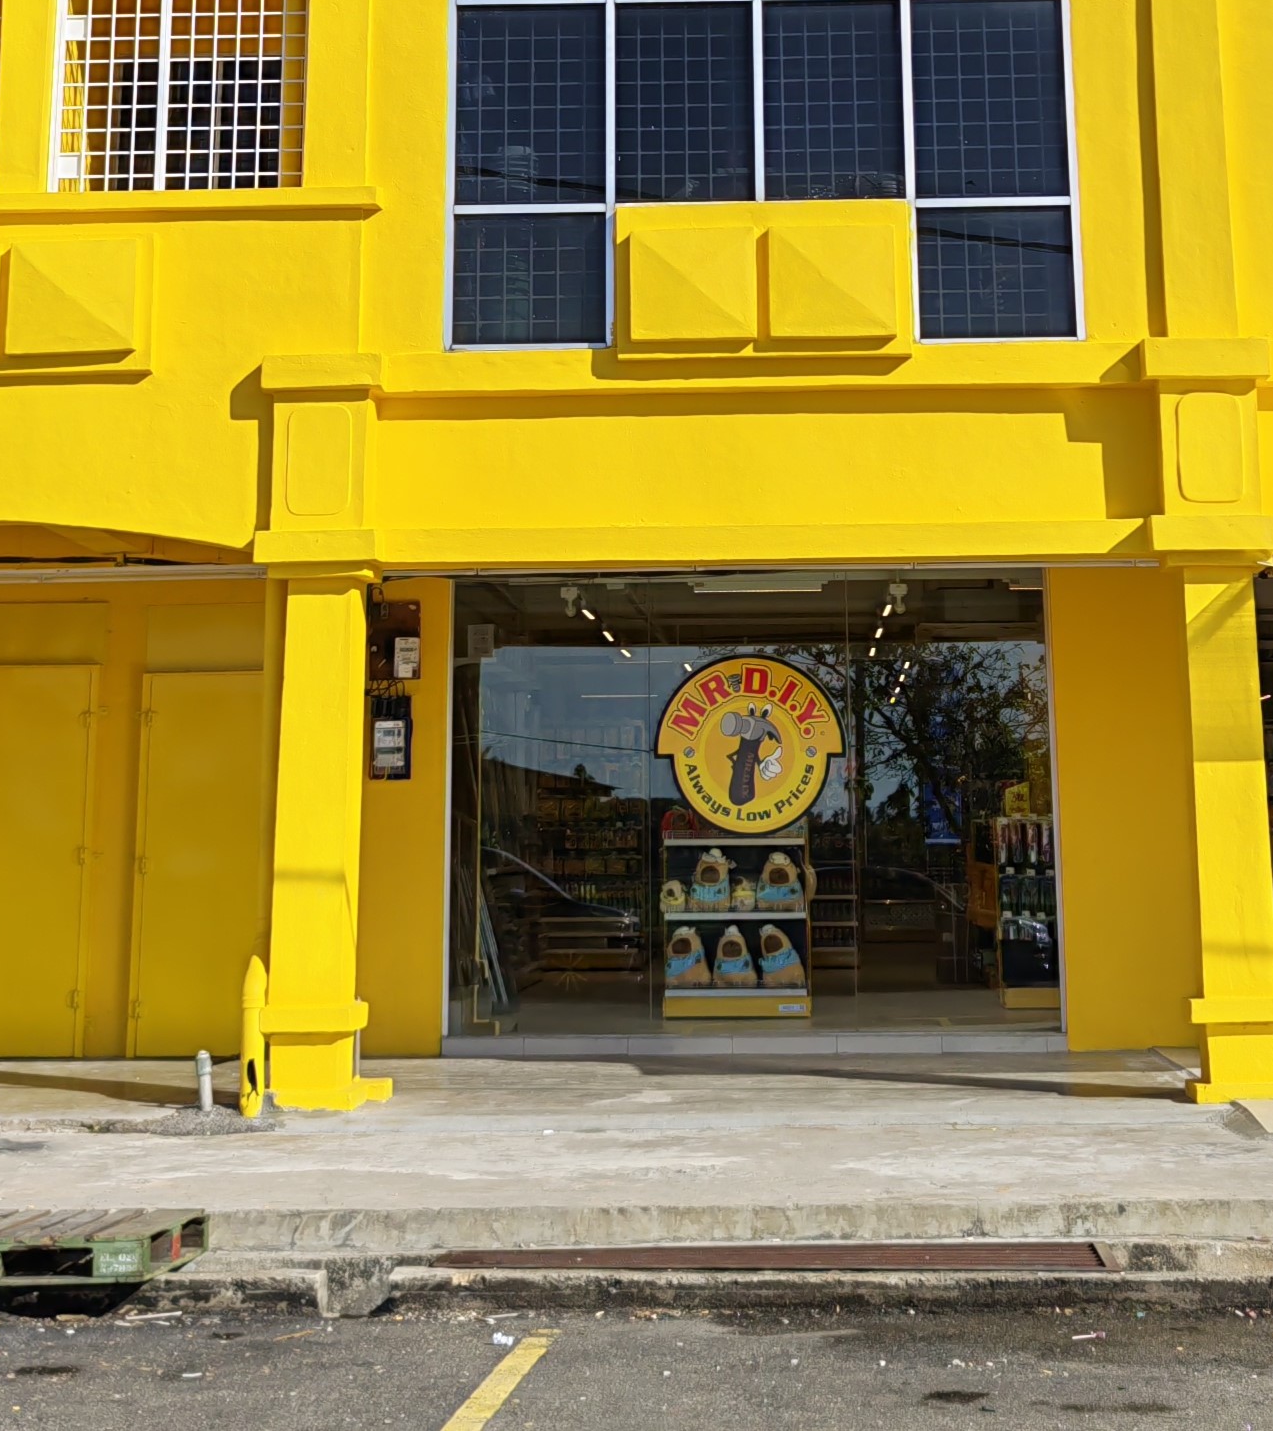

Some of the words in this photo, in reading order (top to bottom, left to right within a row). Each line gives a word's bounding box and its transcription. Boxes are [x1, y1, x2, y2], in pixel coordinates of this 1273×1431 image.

[684, 763, 731, 817] Always
[736, 807, 772, 822] Low
[774, 763, 815, 815] Prices
